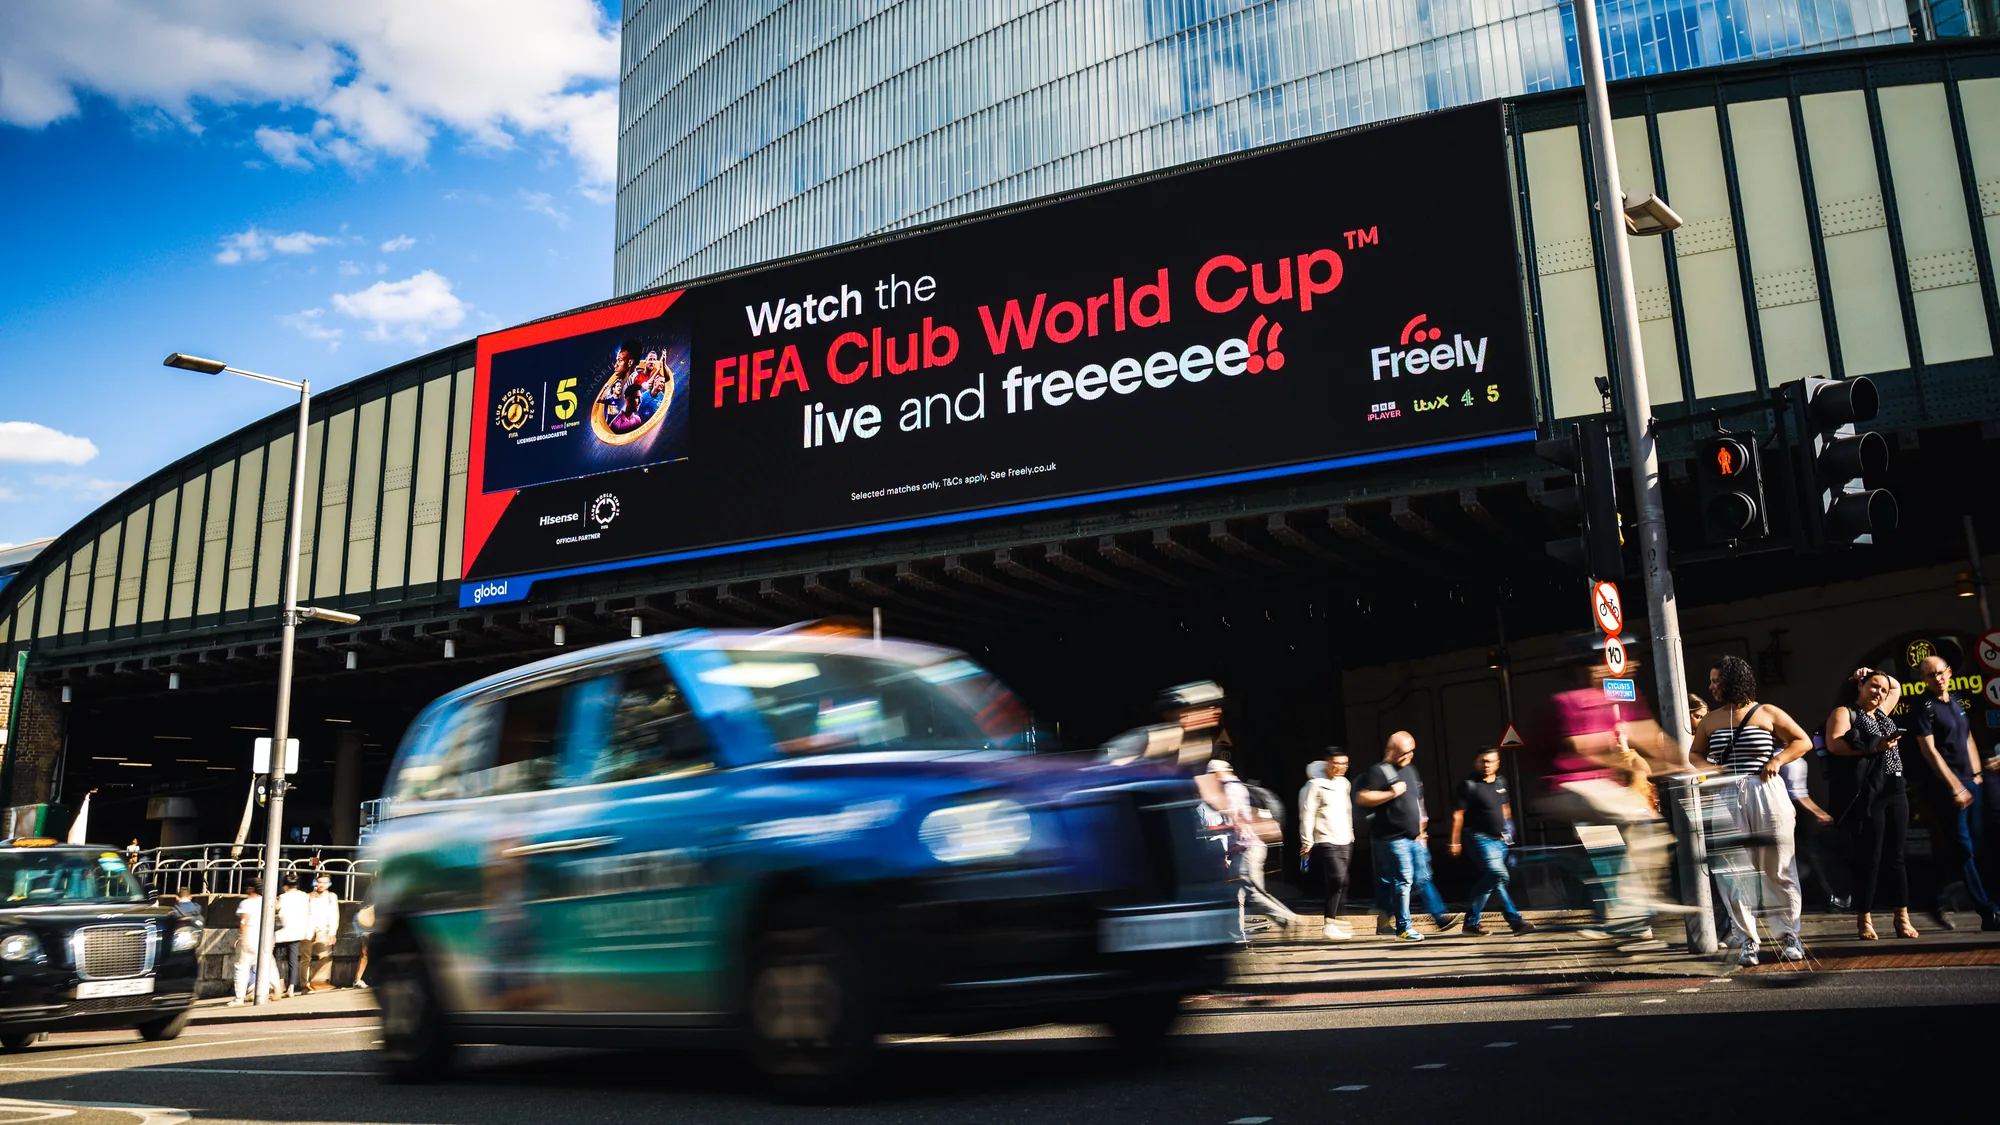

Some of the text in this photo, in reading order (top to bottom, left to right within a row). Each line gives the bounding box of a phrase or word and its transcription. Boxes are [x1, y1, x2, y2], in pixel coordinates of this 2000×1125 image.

[745, 274, 936, 337] Watch the
[714, 344, 810, 408] FIFA
[826, 316, 960, 385] Club
[977, 268, 1171, 355] World
[1371, 333, 1488, 381] Freely
[555, 377, 578, 420] 5
[1461, 389, 1474, 406] 4
[1487, 384, 1500, 403] 5
[803, 402, 882, 449] live
[899, 376, 985, 432] and
[517, 430, 567, 445] LICENSED BROADCASTER
[851, 462, 1057, 501] Selected matches only. T&Cs apply. See Freely.co.uk
[539, 513, 579, 526] Hisense
[556, 533, 601, 545] OFFICIAL PARTNER
[474, 581, 508, 604] global
[1606, 682, 1631, 690] CYCLISTS
